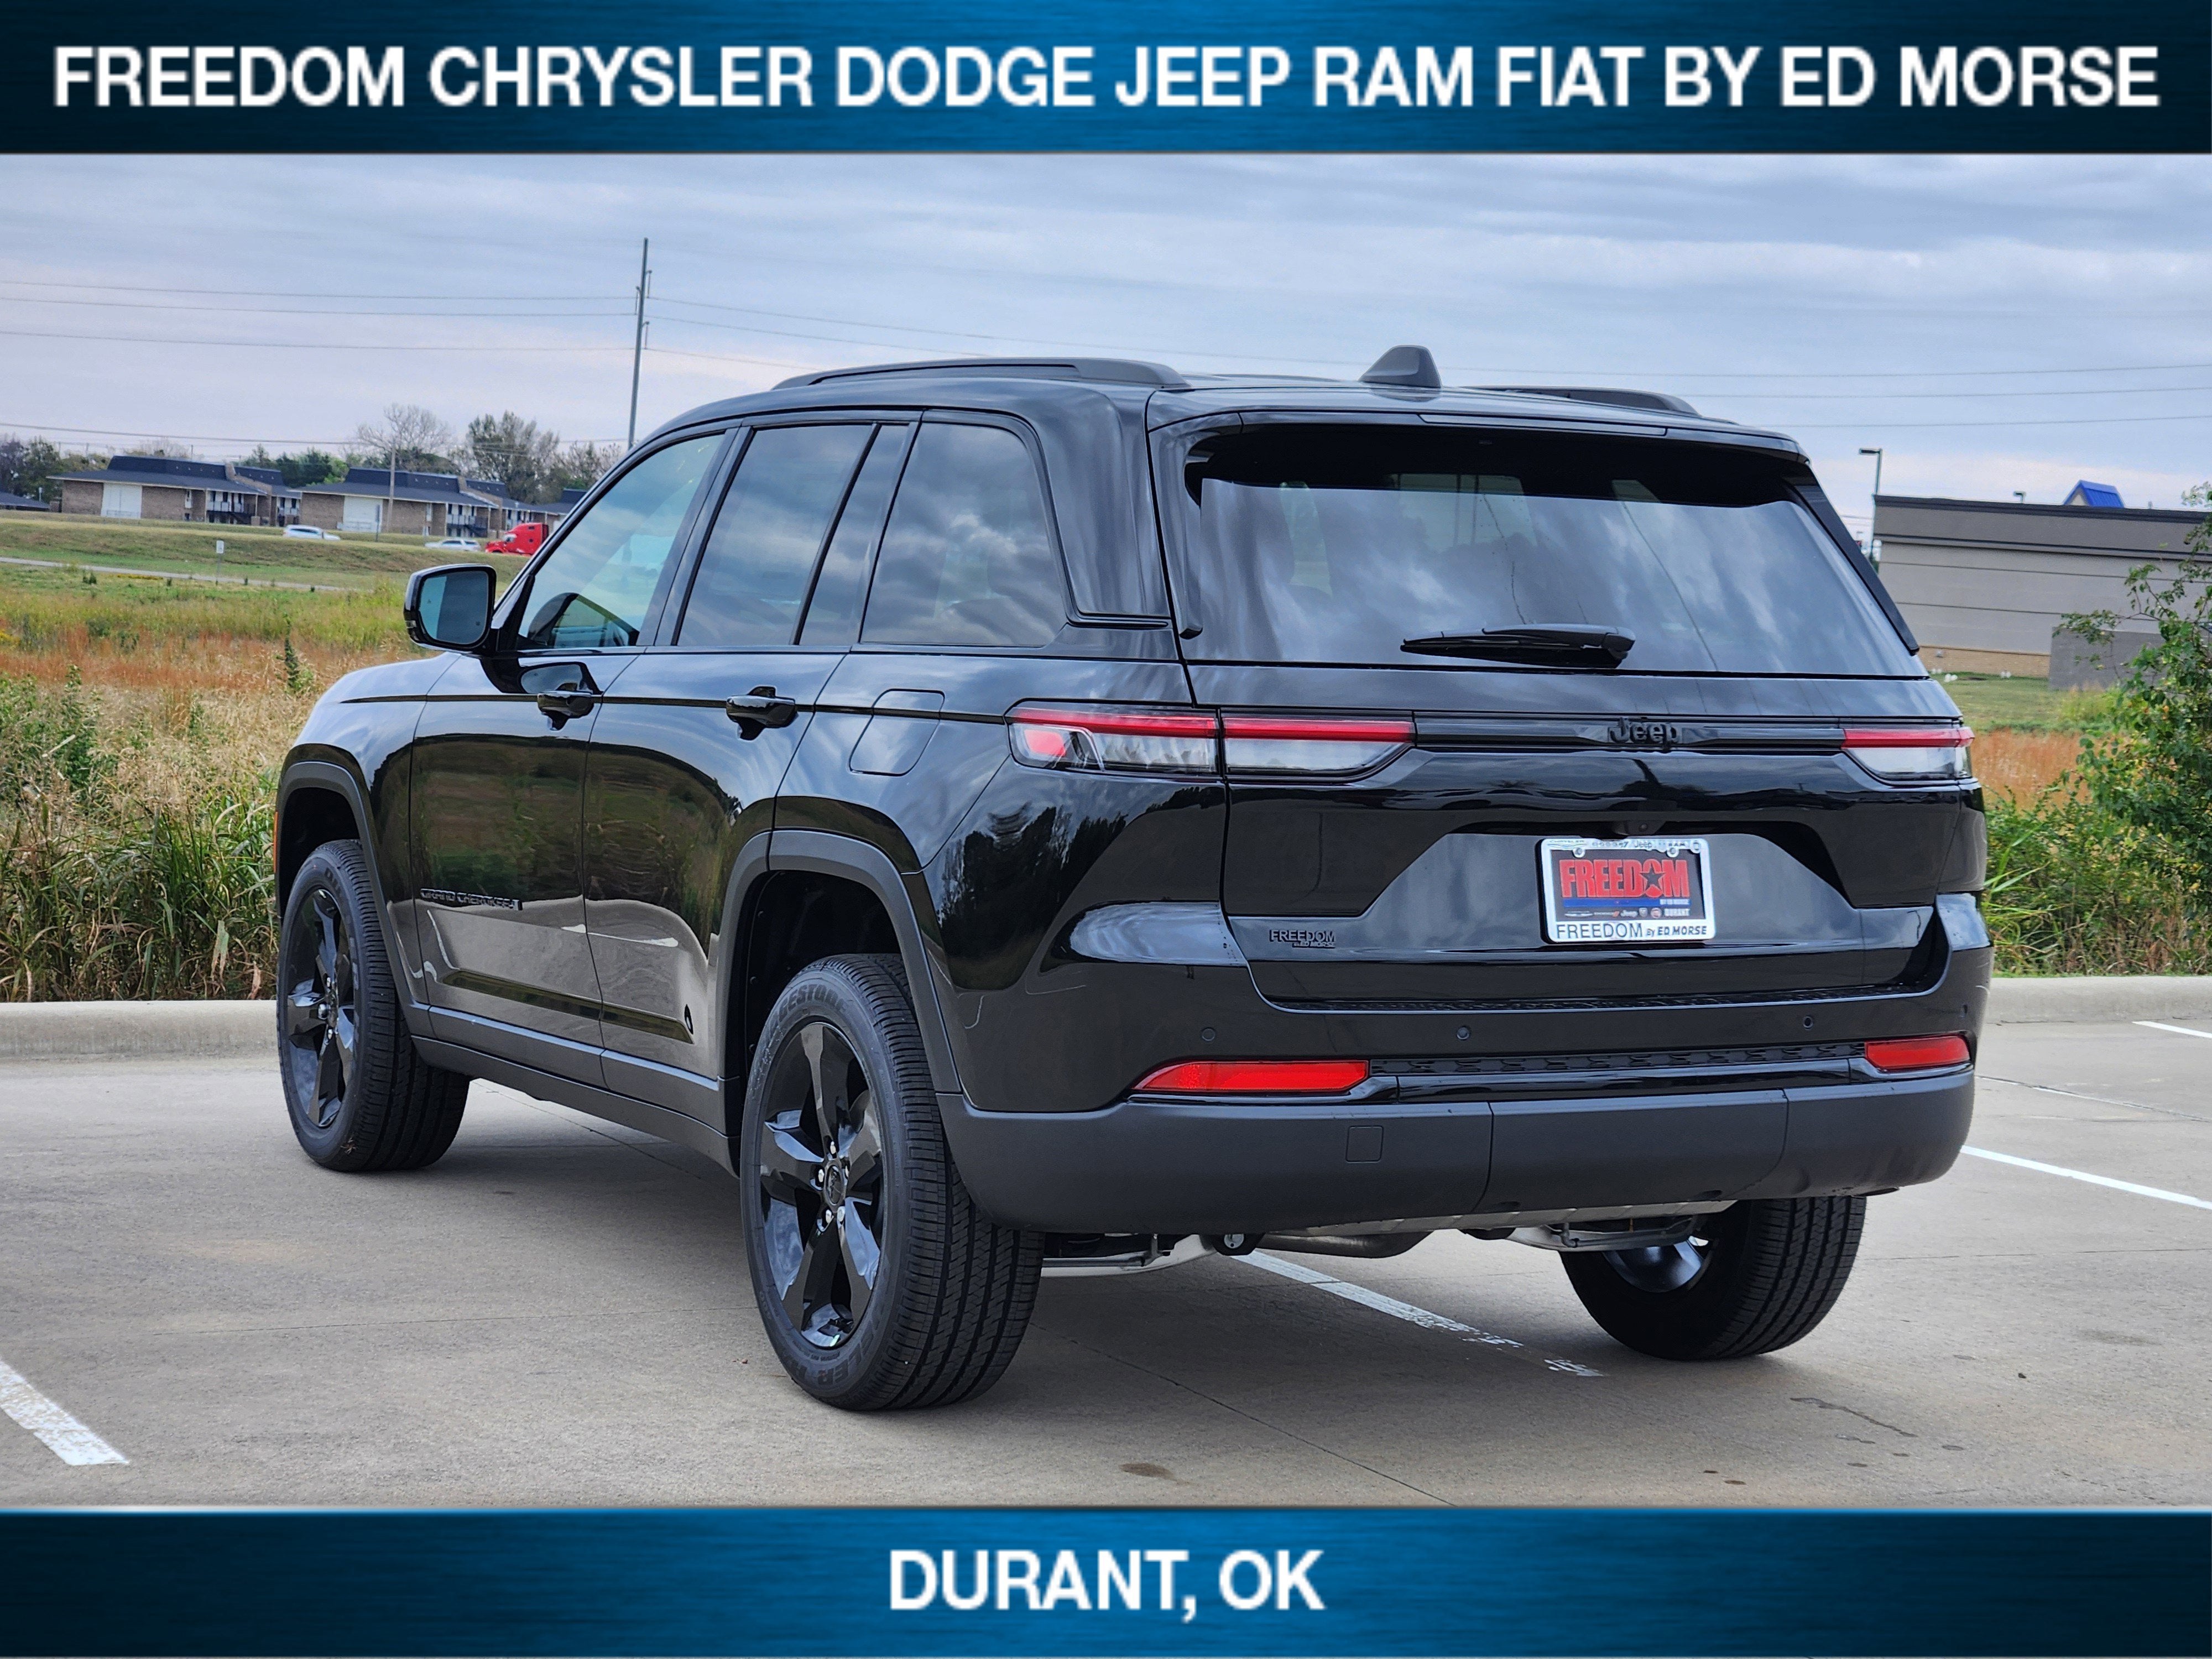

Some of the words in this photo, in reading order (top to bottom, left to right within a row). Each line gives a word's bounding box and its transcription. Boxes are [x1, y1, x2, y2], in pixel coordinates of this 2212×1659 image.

[1608, 717, 1679, 749] Jeep
[1559, 858, 1690, 898] FREEDOM
[1270, 930, 1335, 942] FREEDOM
[1556, 923, 1642, 938] FREEDOM
[1658, 926, 1670, 935] ED
[1672, 926, 1707, 935] MORSE
